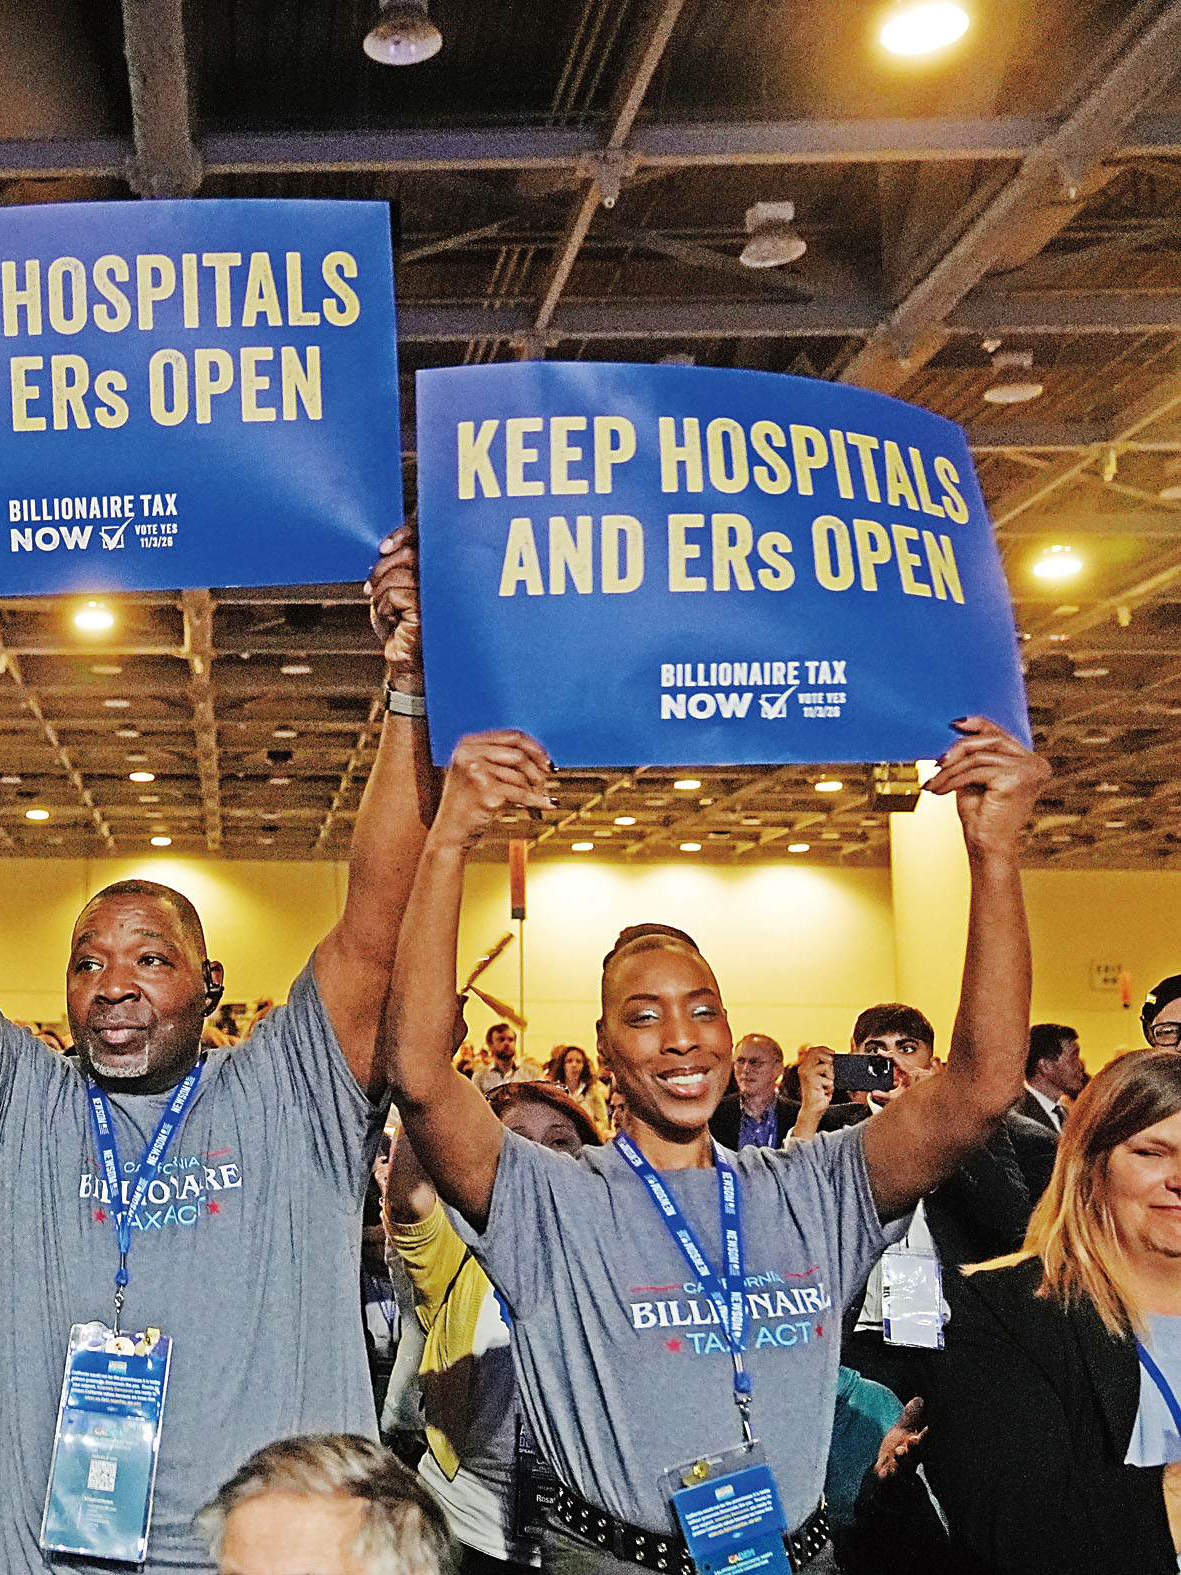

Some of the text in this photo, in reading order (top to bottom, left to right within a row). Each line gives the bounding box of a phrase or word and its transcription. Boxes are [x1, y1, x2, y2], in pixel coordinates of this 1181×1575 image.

[2, 250, 360, 336] HOSPITALS
[11, 353, 128, 433] ERs
[149, 346, 322, 427] OPEN
[457, 416, 969, 525] KEEP HOSPITALS
[9, 493, 177, 522] BILLIONAIRE TAX
[11, 526, 93, 552] NOW
[135, 524, 177, 535] VOTE YES
[140, 536, 173, 548] 11/3/26
[499, 513, 965, 605] AND ERs OPEN
[661, 661, 847, 687] BILLIONAIRE TAX
[661, 693, 753, 719] NOW
[797, 693, 846, 704] VOTE YES
[170, 1085, 189, 1114] NEWSOM
[146, 1133, 168, 1166] NEWSOM
[103, 1149, 118, 1184] NEWSOM
[684, 1241, 711, 1277] NEWSOM
[726, 1229, 740, 1265] NEWSOM
[730, 1291, 744, 1333] NEWSOM
[755, 1321, 811, 1349] ACT
